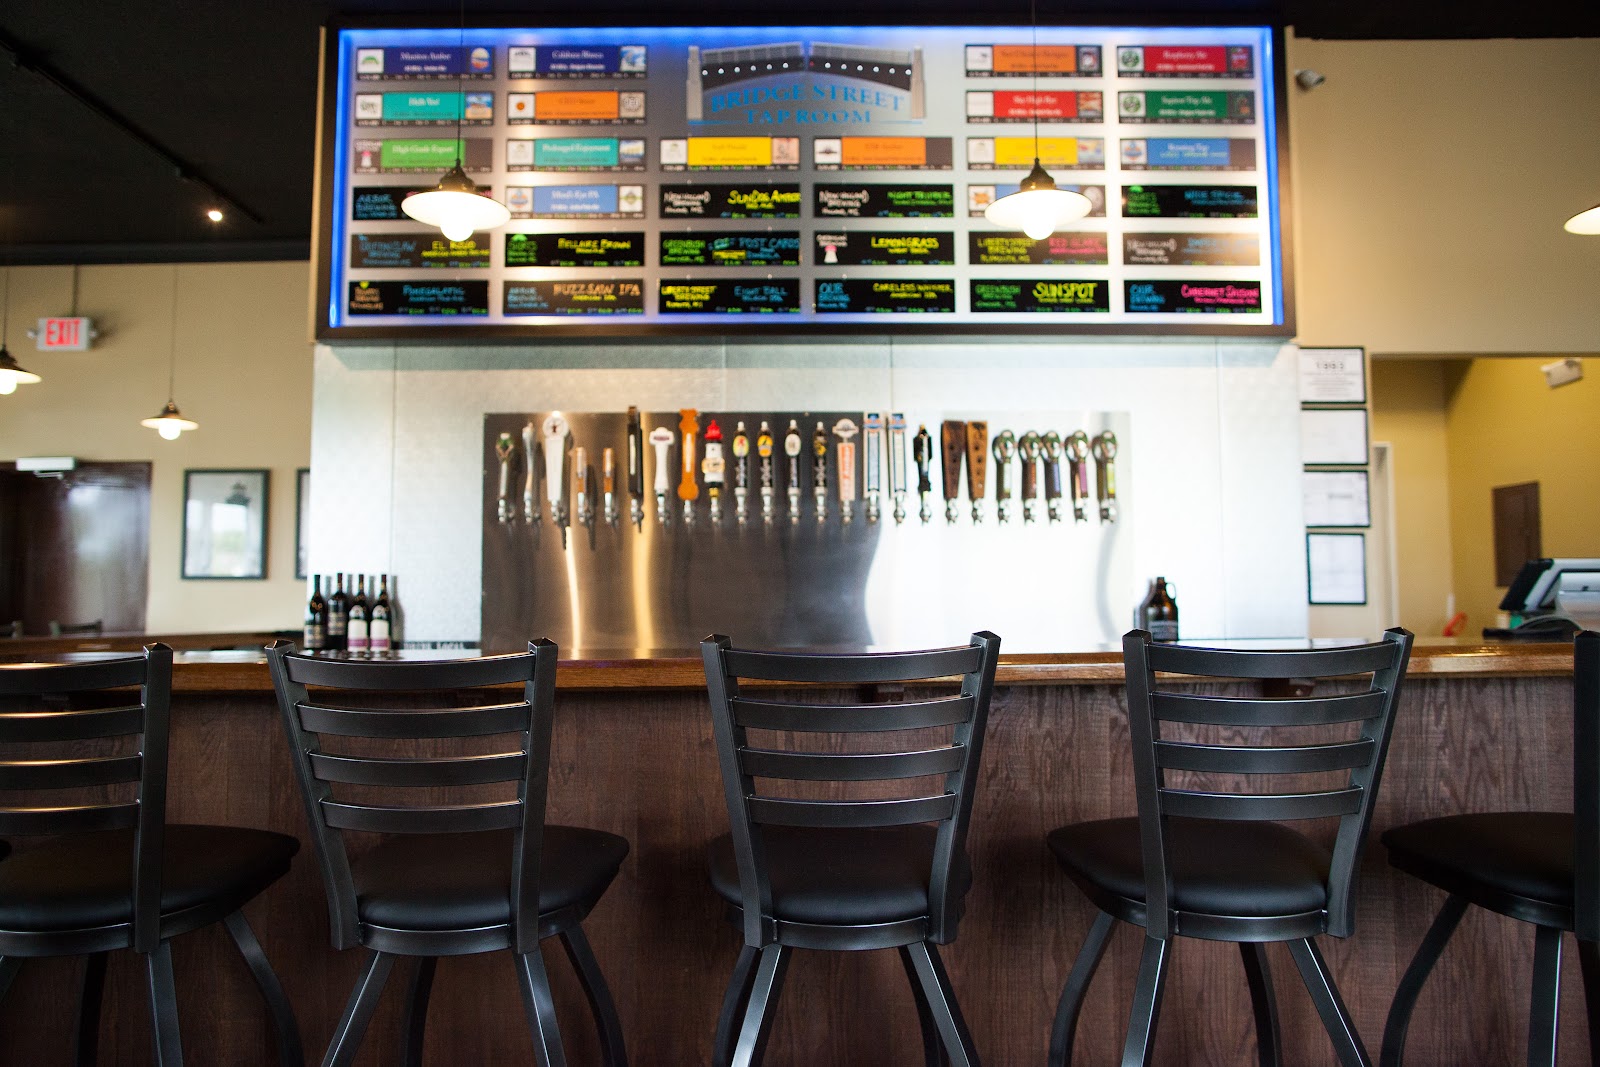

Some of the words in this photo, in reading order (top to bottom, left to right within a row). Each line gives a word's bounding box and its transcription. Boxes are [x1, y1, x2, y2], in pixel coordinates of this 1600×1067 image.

[711, 83, 805, 113] BRIDGE
[812, 84, 905, 111] STREET
[1032, 282, 1098, 299] SUNSPOT
[46, 318, 81, 346] EXIT
